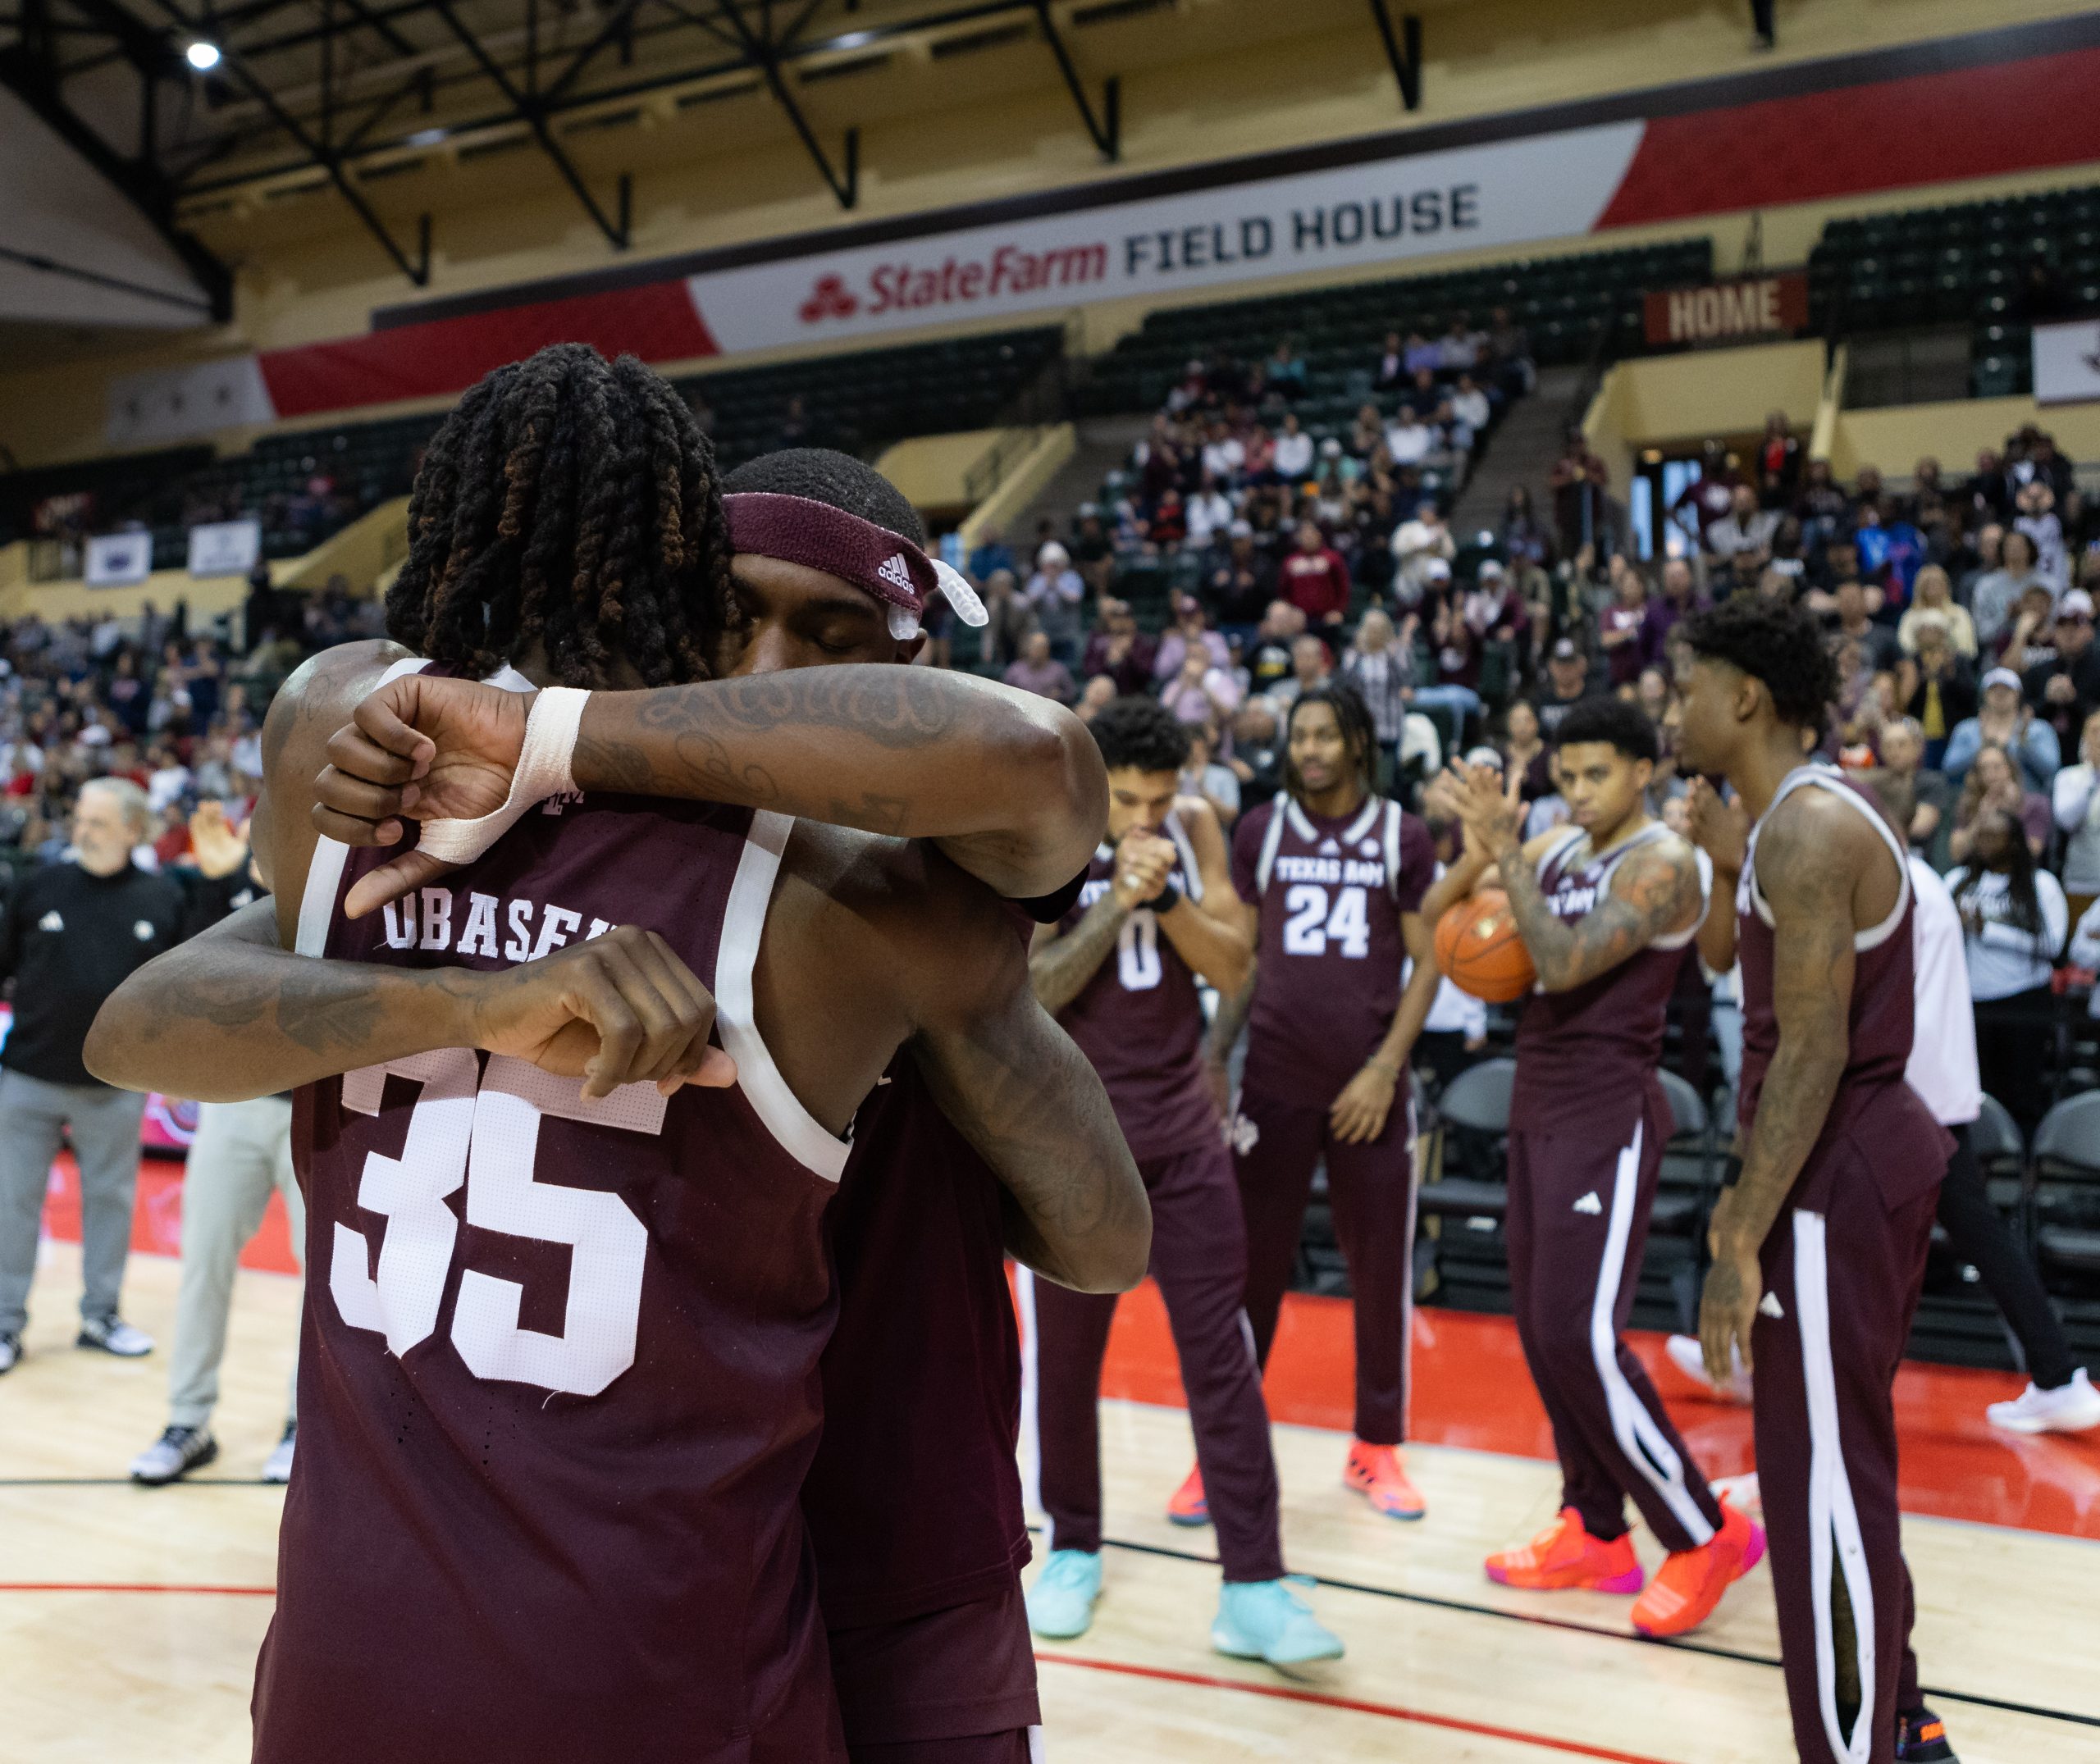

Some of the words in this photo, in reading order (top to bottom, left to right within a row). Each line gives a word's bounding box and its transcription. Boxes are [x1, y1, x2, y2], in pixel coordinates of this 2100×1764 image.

[1125, 216, 1273, 276] FIELD
[1291, 184, 1479, 253] HOUSE
[1669, 280, 1782, 341] HOME
[879, 566, 915, 595] adidas
[1276, 855, 1341, 883] TEXAS
[383, 887, 617, 962] OBASE
[1117, 907, 1162, 991] 0
[1283, 884, 1370, 959] 24
[330, 1047, 669, 1397] 35
